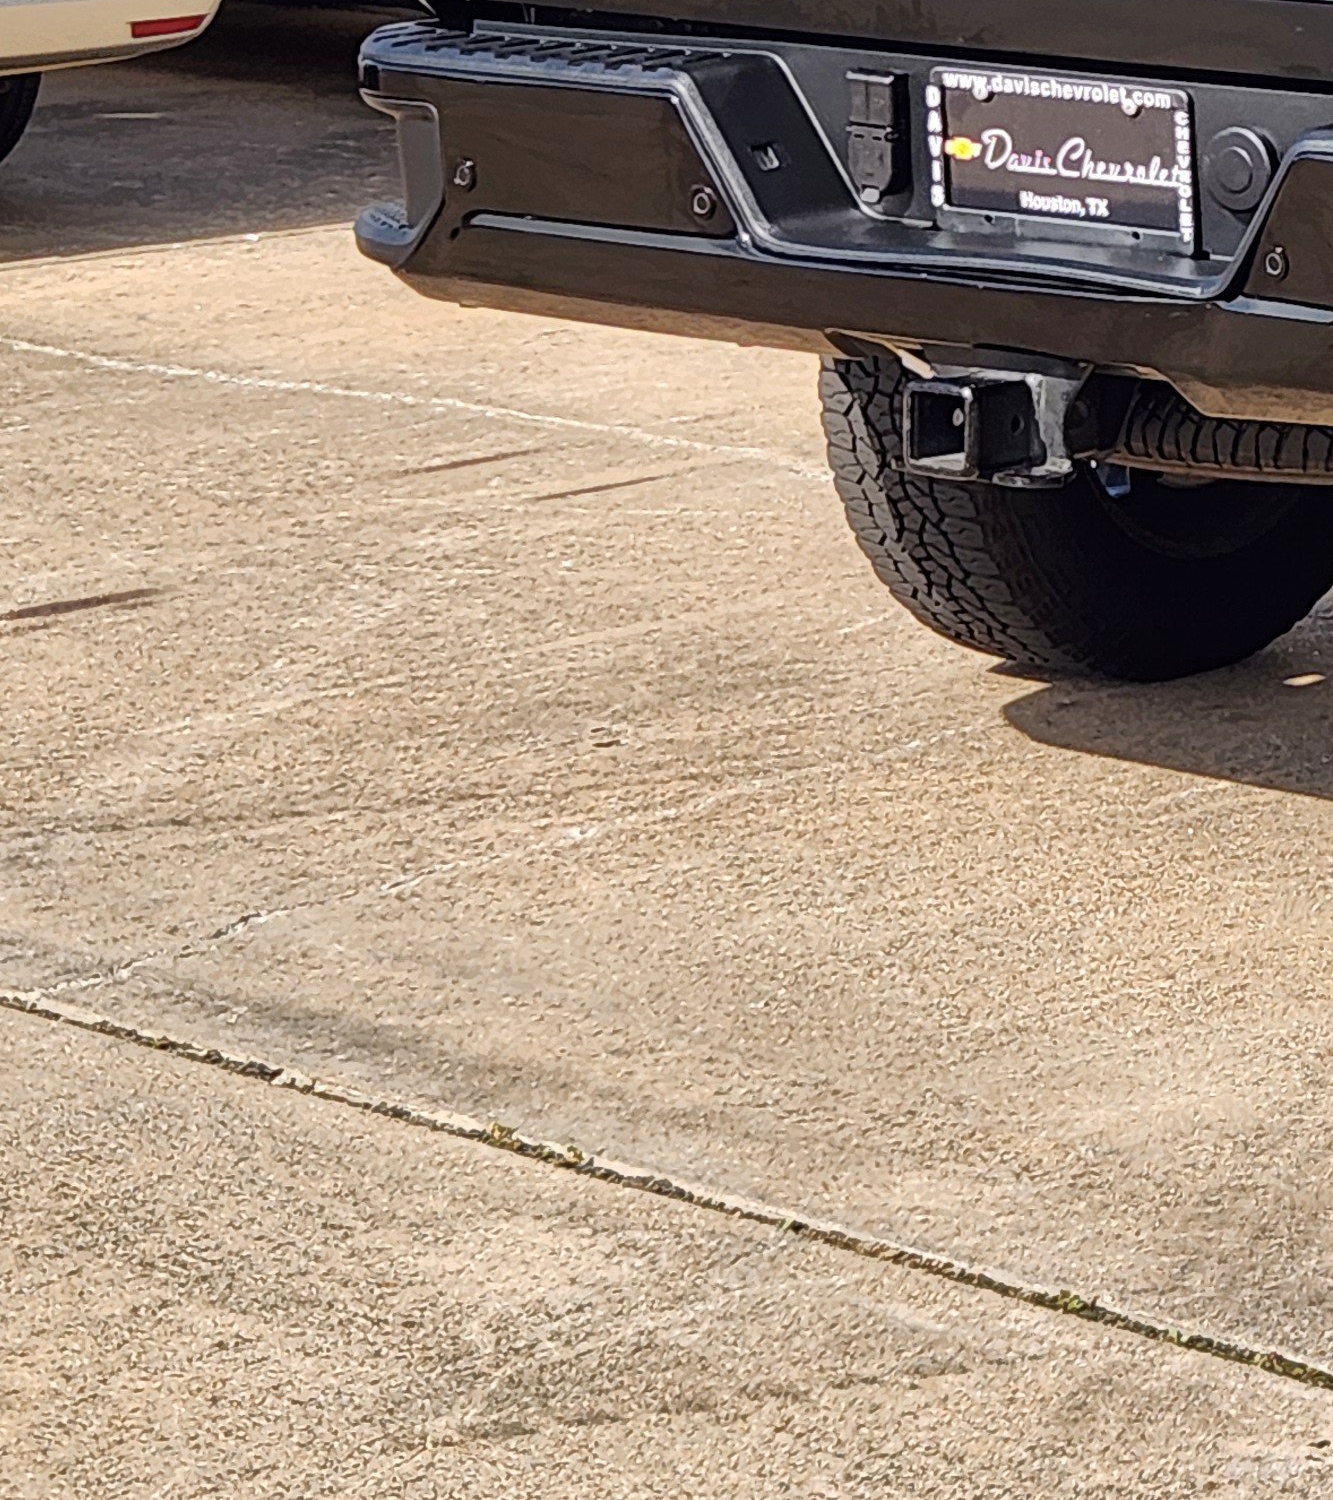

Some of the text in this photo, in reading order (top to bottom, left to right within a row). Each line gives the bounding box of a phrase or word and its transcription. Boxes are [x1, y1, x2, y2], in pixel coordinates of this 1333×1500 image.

[942, 71, 1172, 109] www.davischevrolet.com
[926, 84, 946, 207] DAVIS
[981, 127, 1182, 188] Davis Chevrolet
[1173, 109, 1194, 242] CHEVROLET
[1084, 196, 1110, 218] TX
